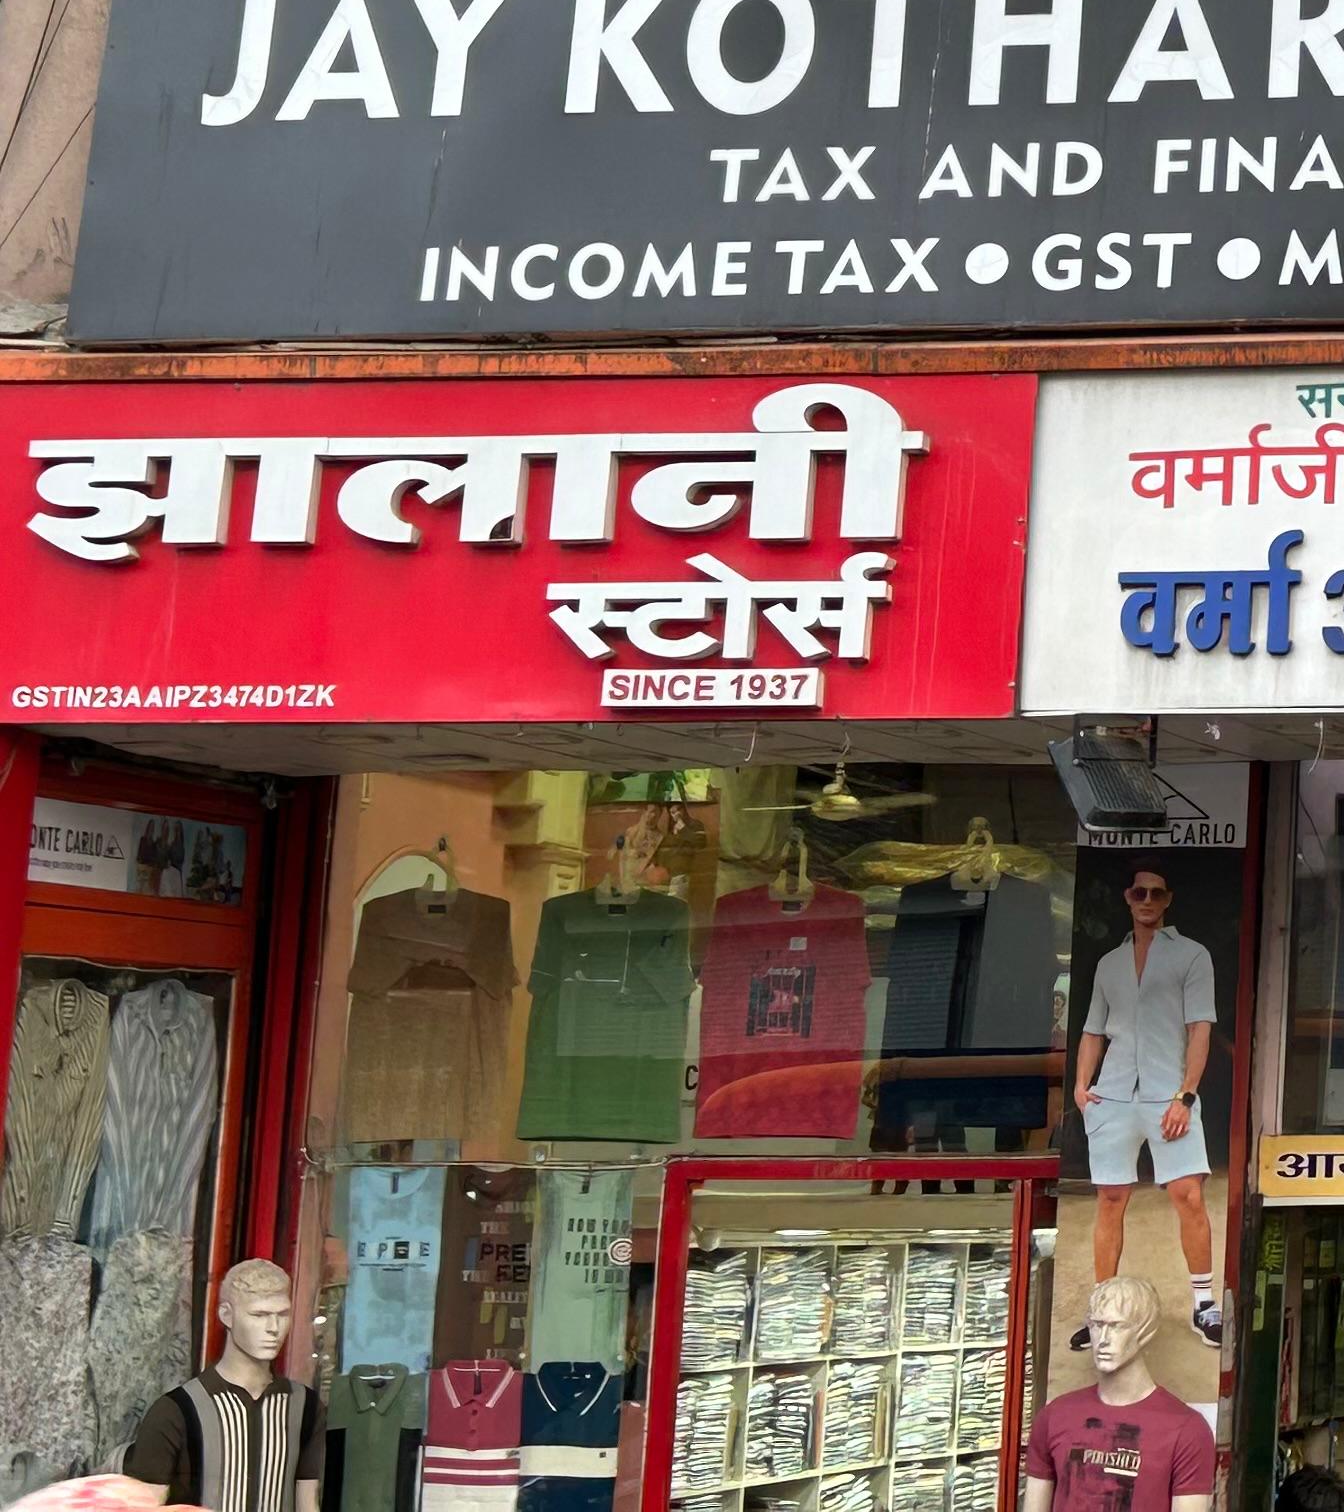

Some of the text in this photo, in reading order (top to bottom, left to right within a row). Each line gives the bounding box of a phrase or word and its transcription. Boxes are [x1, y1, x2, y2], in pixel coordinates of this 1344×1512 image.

[708, 145, 877, 204] TAX
[918, 140, 1104, 199] AND
[418, 241, 748, 304] INCOME
[772, 236, 942, 296] TAX
[1029, 231, 1194, 292] GST
[25, 383, 931, 564] झालानी
[546, 551, 894, 664] स्टोर्स
[1118, 528, 1306, 660] वर्मा
[607, 672, 811, 704] SINCE 1937
[29, 823, 104, 857] ONTE CARLO
[1170, 822, 1236, 845] CARLO
